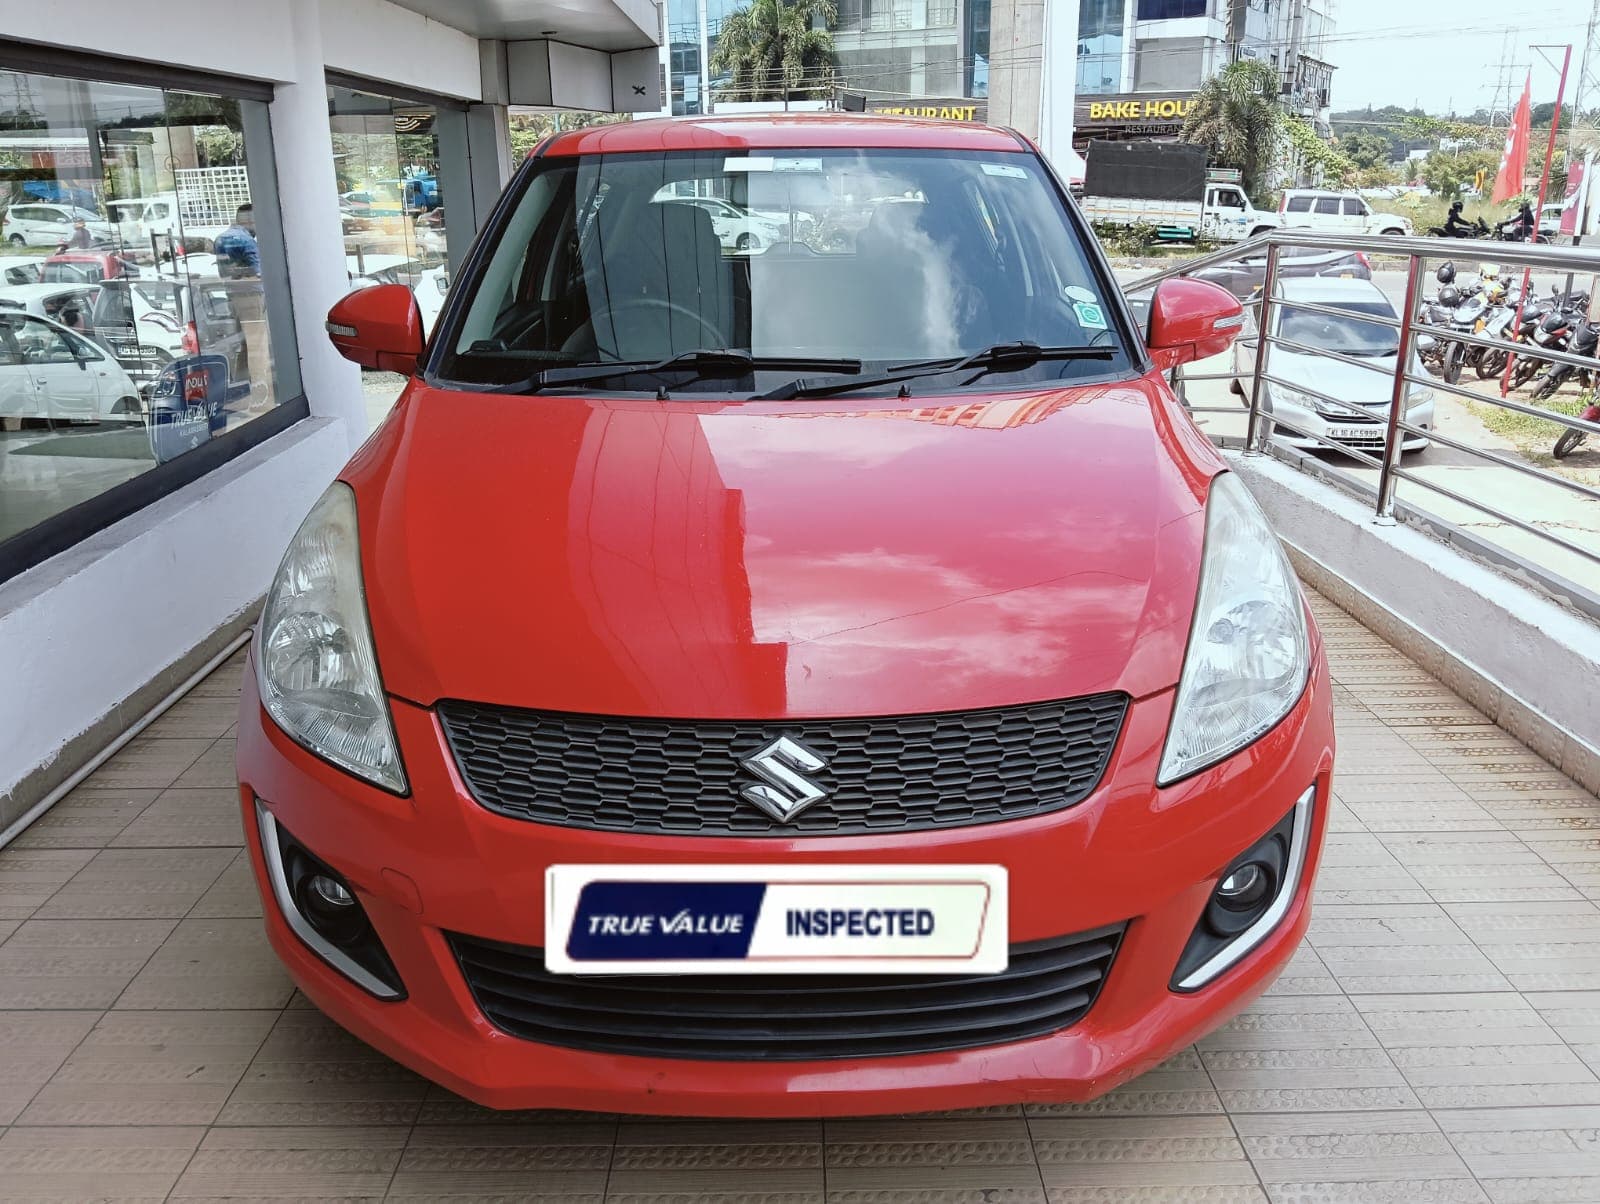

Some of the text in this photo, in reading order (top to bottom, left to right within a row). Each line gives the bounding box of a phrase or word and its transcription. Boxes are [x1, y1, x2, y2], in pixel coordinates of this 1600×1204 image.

[873, 105, 977, 121] TAURANT
[1089, 100, 1198, 119] BAKE HOU
[1125, 125, 1181, 135] RESTAURAN
